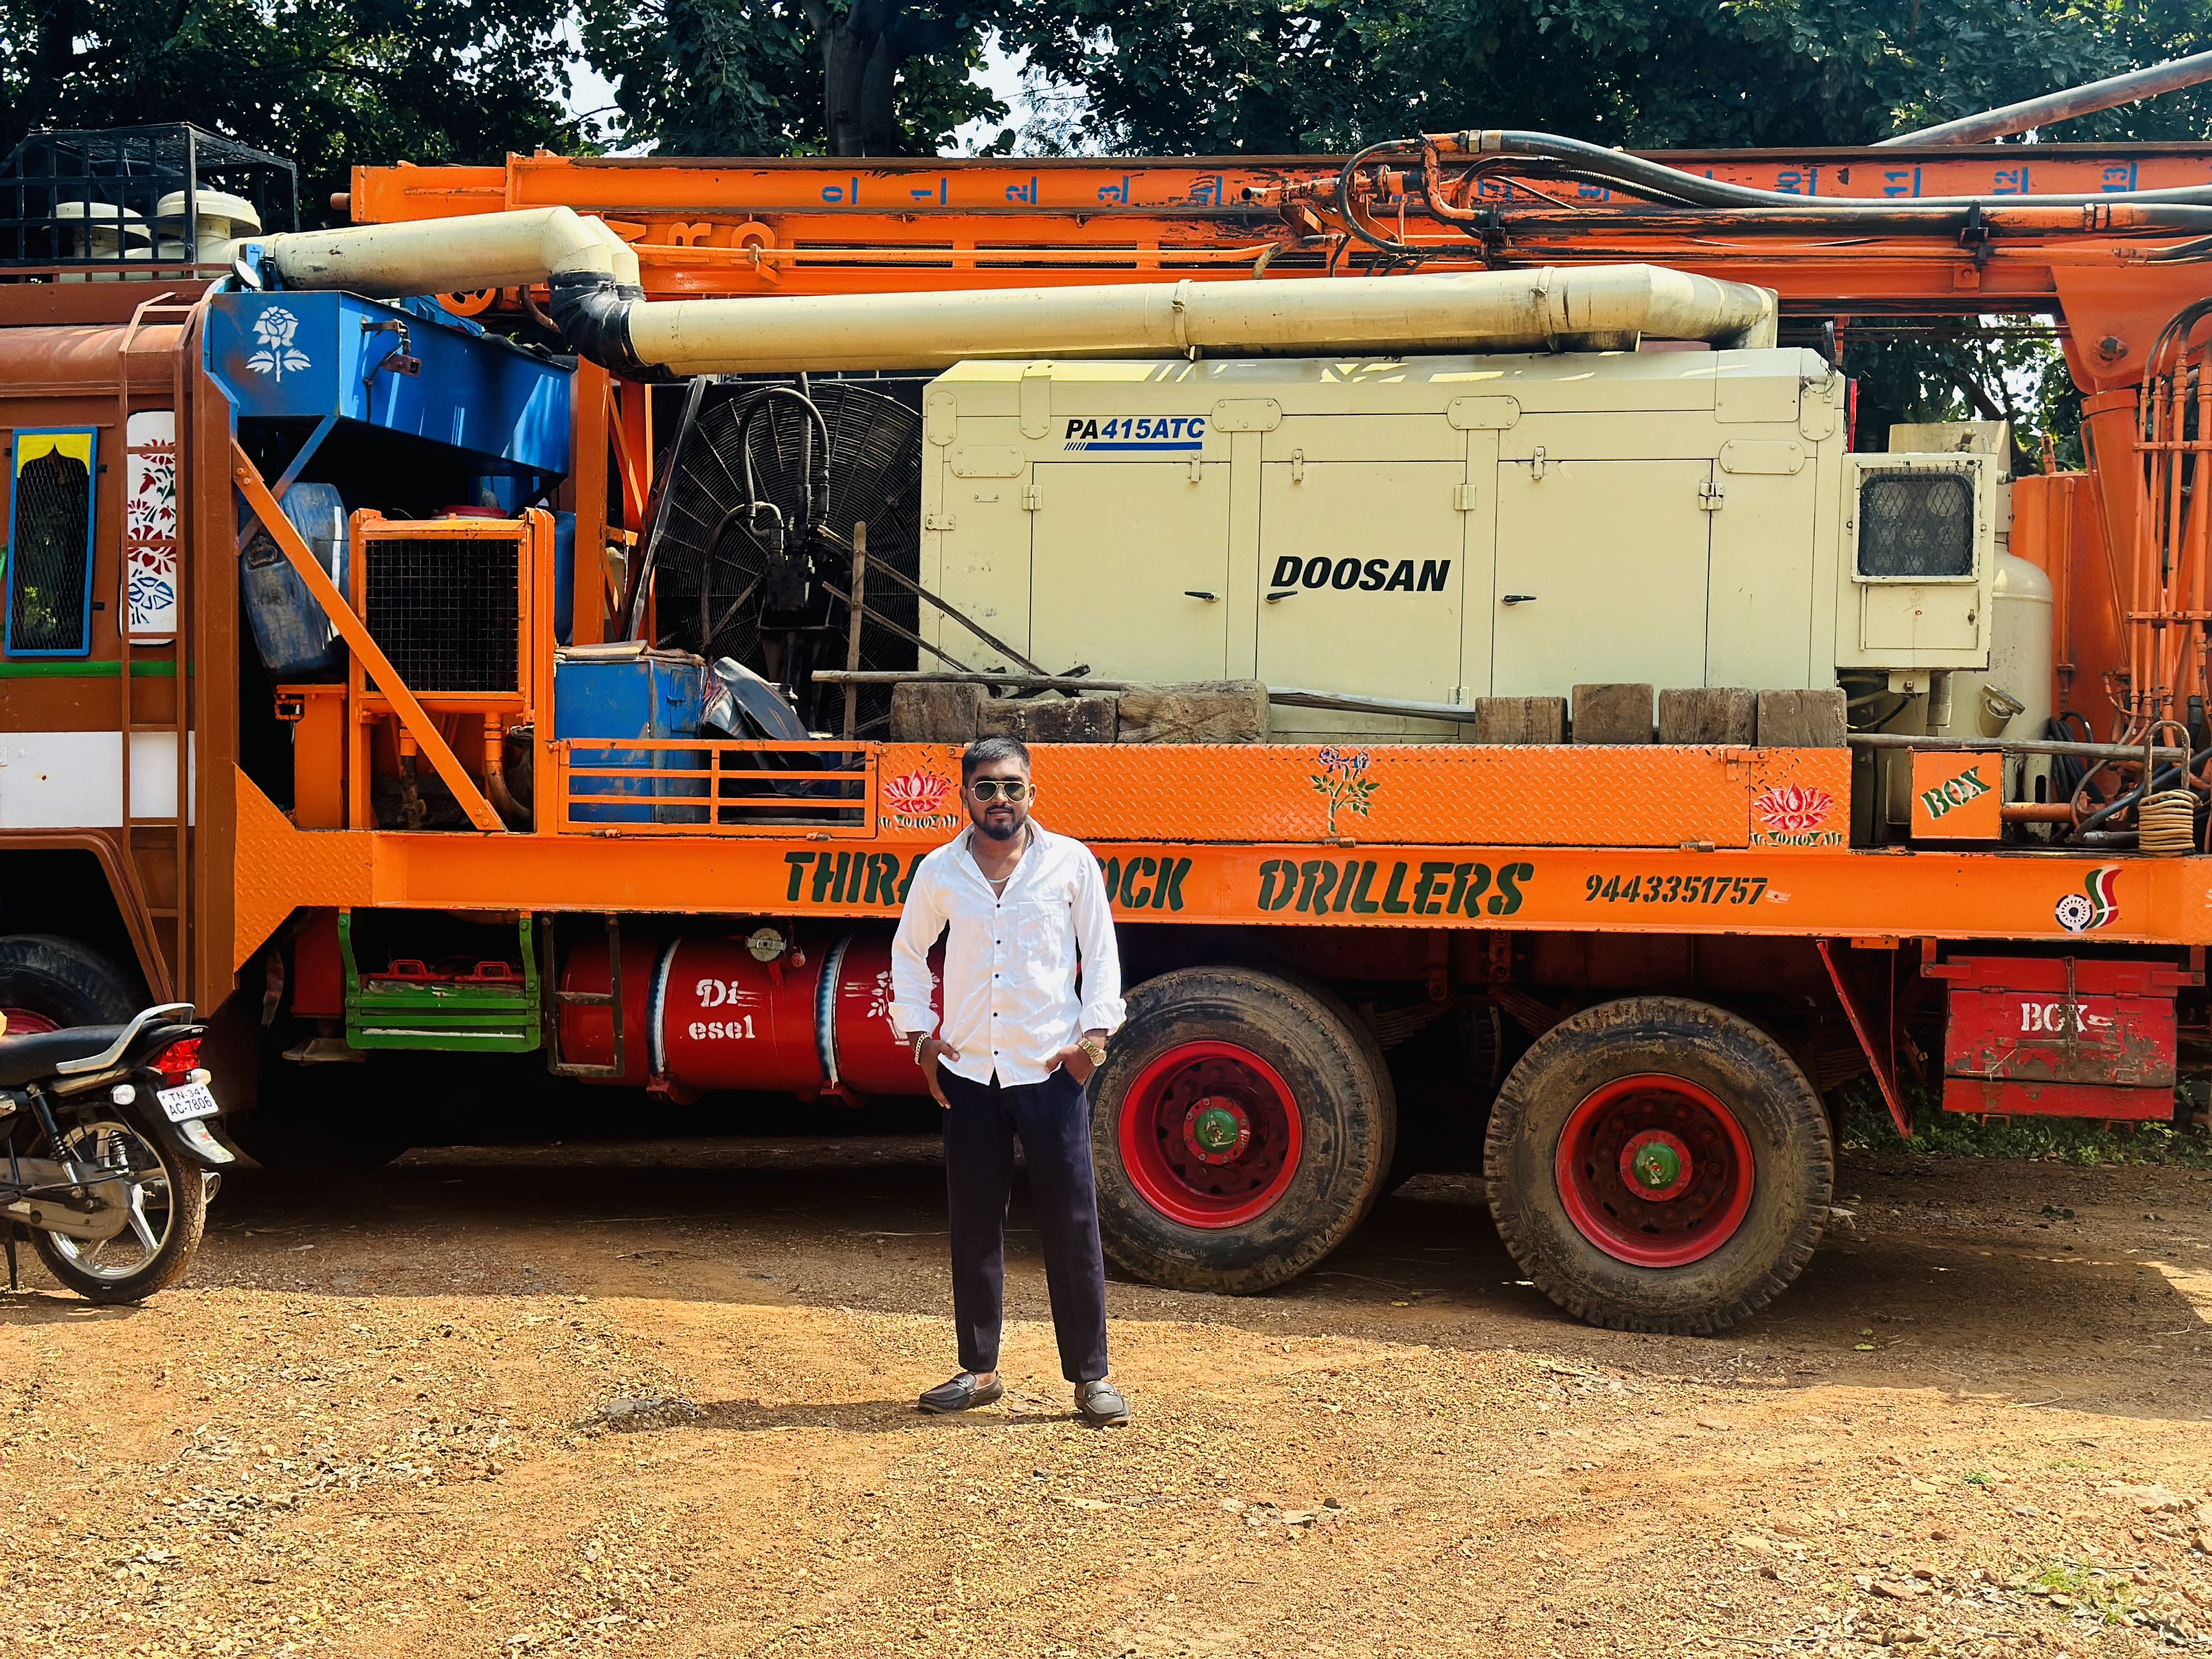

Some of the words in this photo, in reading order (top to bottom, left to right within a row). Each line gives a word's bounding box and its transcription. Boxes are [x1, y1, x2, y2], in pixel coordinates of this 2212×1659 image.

[1006, 185, 1028, 201] 2
[1098, 185, 1120, 201] 3
[1883, 172, 1909, 198] 11
[1065, 418, 1205, 439] PA415ATC
[1271, 556, 1451, 591] DOOSAN
[1920, 765, 1991, 820] BOX
[1258, 859, 1534, 918] DRILLERS
[1585, 874, 1768, 905] 9443351757
[689, 1014, 756, 1040] esel
